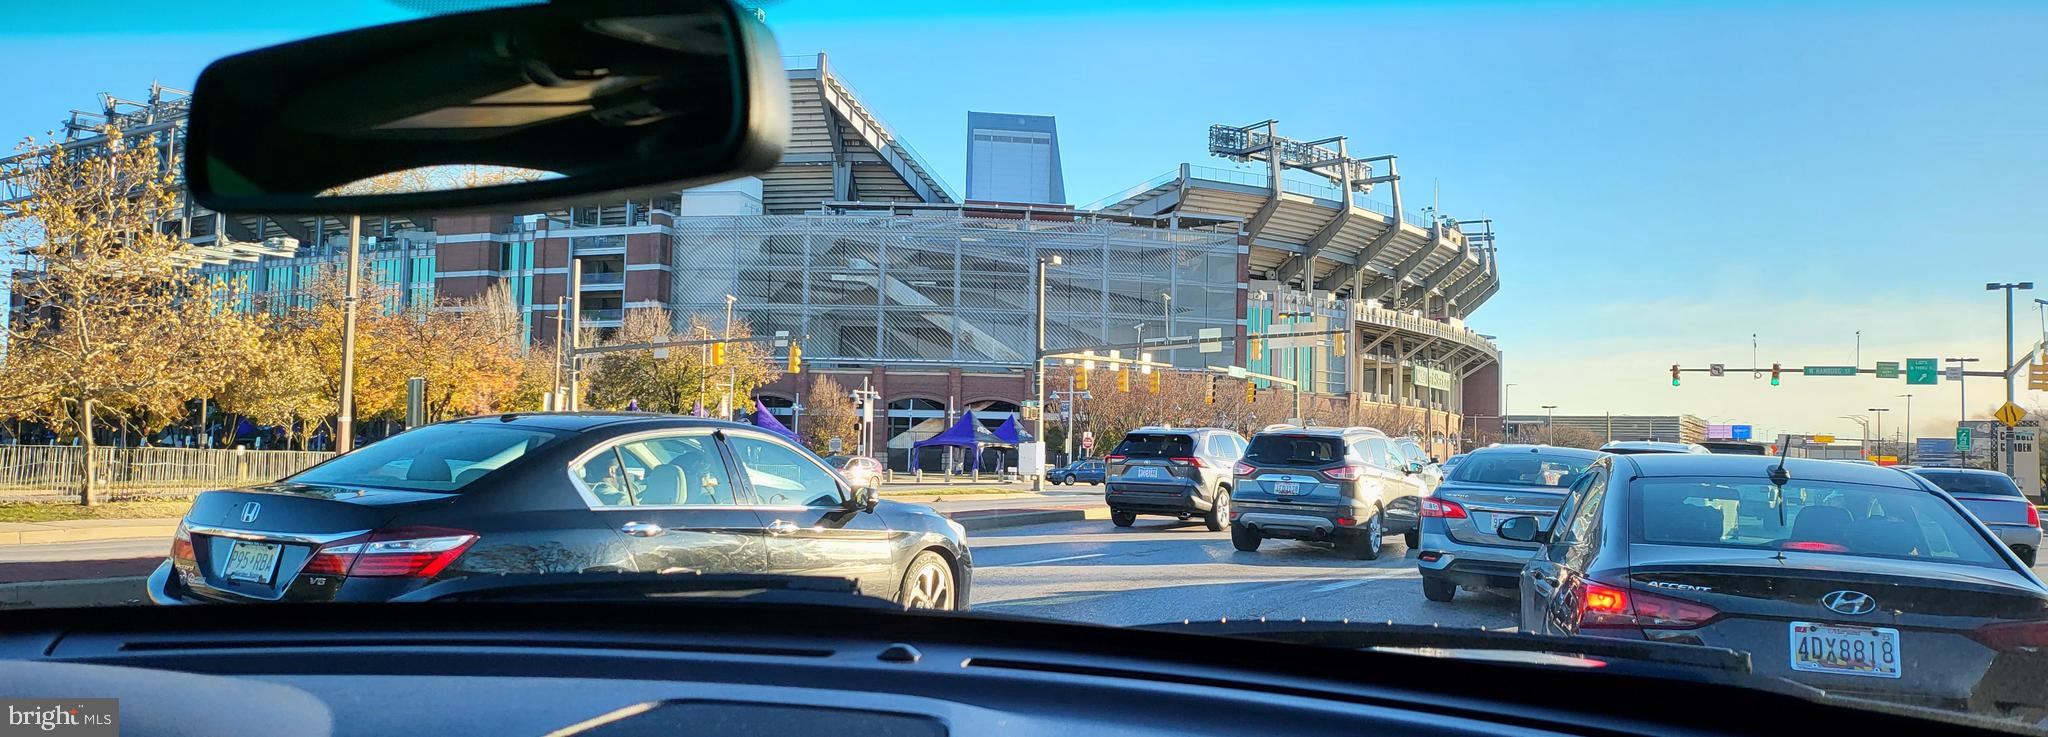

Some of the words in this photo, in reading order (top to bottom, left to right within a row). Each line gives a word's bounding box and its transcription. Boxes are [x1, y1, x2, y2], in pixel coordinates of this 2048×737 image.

[309, 577, 327, 585] V6
[1647, 581, 1712, 592] ACCENT
[1798, 636, 1894, 664] 4DX8818
